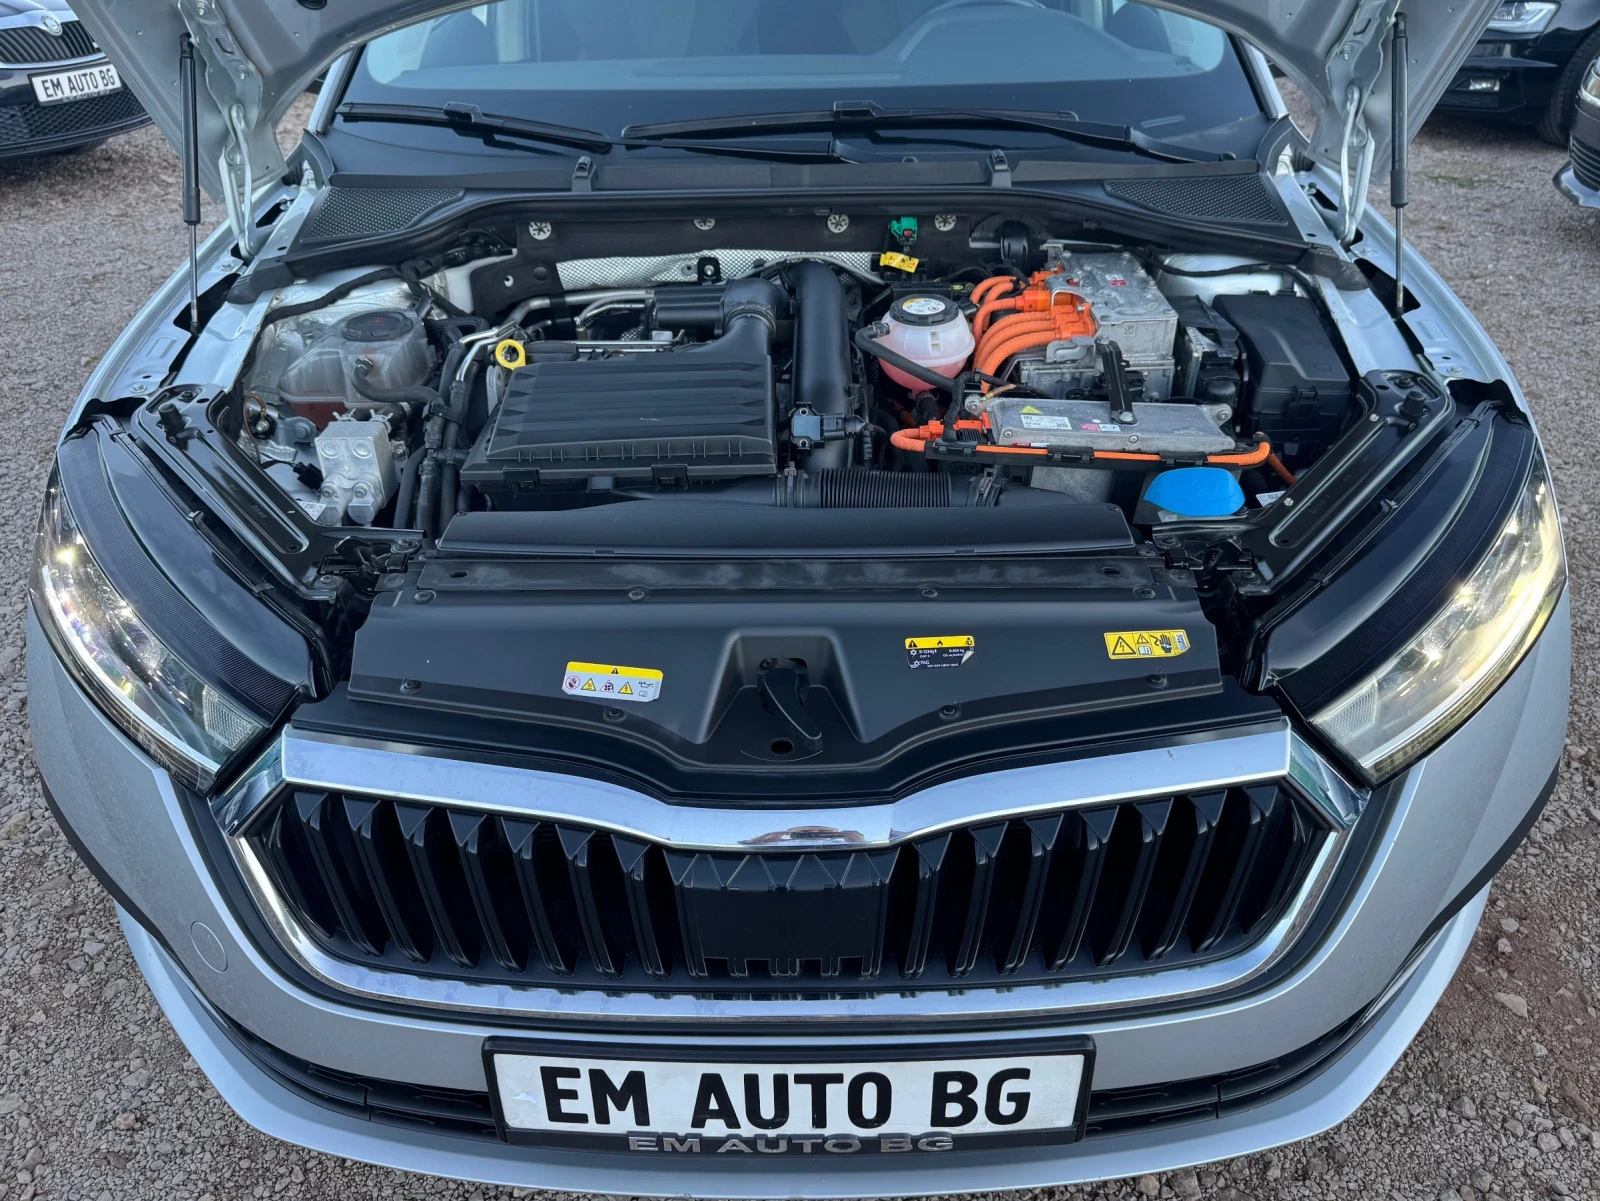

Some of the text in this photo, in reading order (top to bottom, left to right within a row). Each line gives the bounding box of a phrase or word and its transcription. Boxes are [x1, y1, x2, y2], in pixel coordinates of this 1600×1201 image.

[41, 68, 115, 98] EM AUTO BG
[539, 1065, 1031, 1130] EM AUTO BG
[627, 1133, 955, 1154] EM AUTO BG
